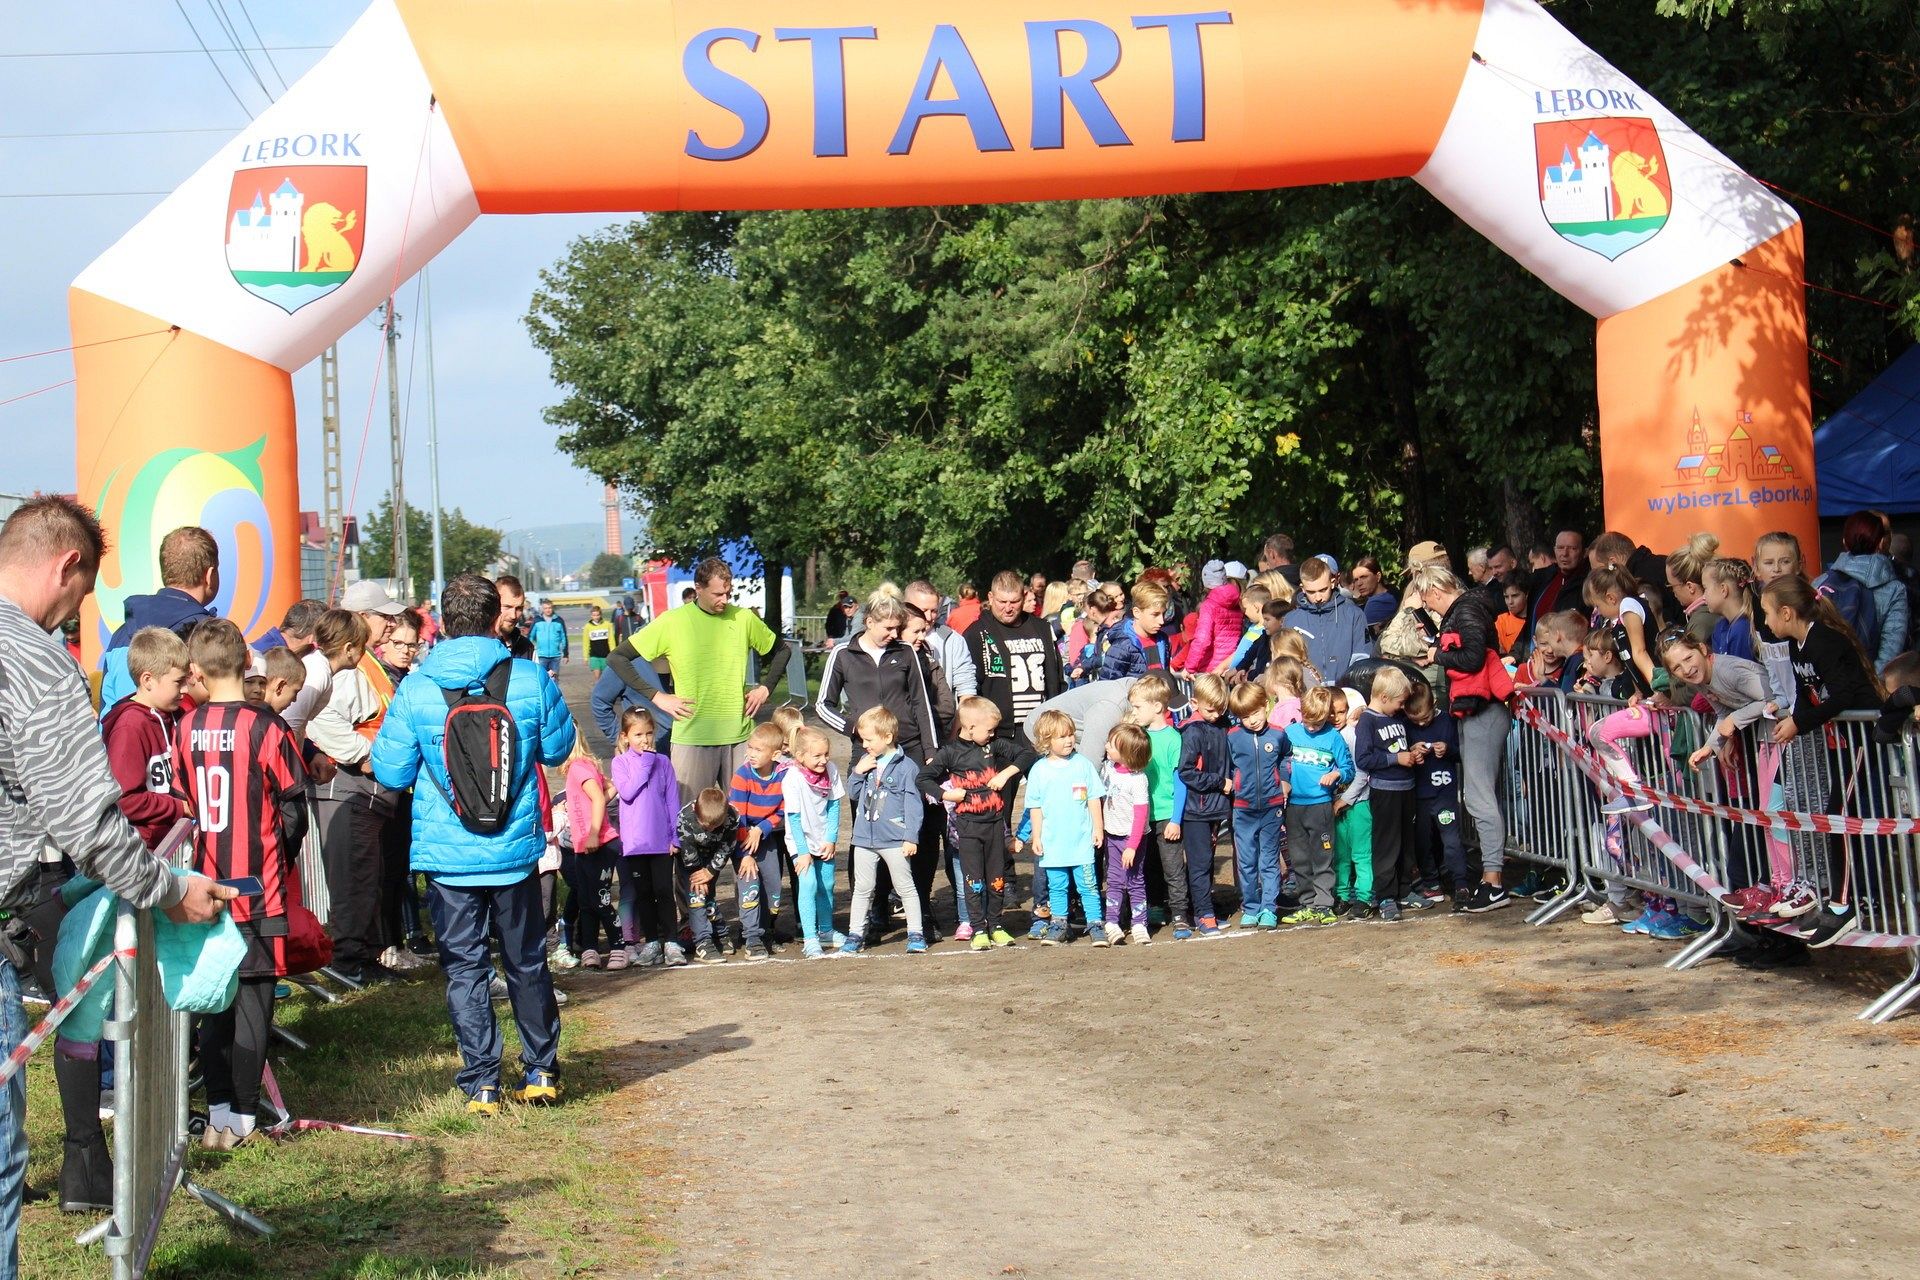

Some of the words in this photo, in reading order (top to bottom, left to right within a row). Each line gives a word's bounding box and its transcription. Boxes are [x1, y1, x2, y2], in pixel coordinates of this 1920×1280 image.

[682, 10, 1233, 162] START
[1535, 88, 1643, 116] LĘBORK
[242, 133, 361, 163] LĘBORK
[1648, 485, 1812, 514] wybierzLębork.pl
[500, 719, 509, 802] KROSS
[1431, 771, 1452, 786] 56
[196, 766, 230, 832] 19
